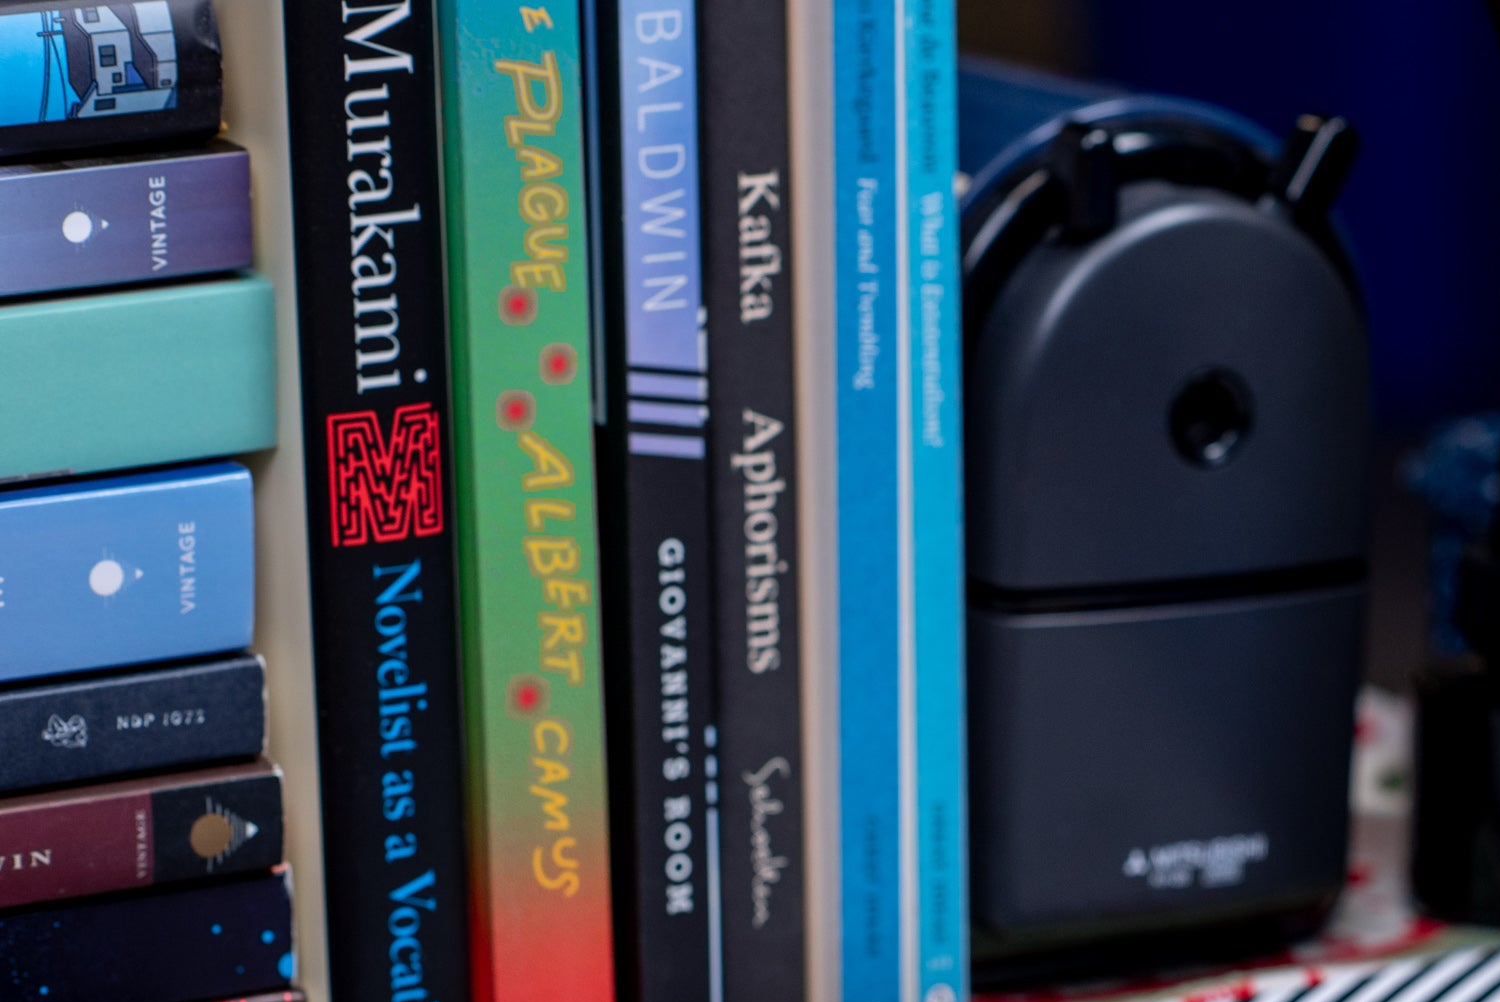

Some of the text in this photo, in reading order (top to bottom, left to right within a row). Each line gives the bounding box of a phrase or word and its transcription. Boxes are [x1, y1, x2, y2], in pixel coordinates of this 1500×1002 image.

[148, 176, 168, 271] VINTAGE
[341, 0, 428, 395] Murakami
[495, 51, 568, 291] PLAGUE
[635, 9, 688, 312] BALDWIN
[856, 178, 879, 225] Fear
[737, 168, 782, 324] Kafka
[857, 229, 880, 274] and
[178, 521, 196, 614] VINTAGE
[518, 431, 592, 688] ALBERT
[731, 409, 788, 674] Aphorisms
[372, 559, 428, 758] Novelist
[658, 537, 693, 914] GIOVANNI'S ROOM
[135, 808, 148, 879] VINTAGE
[382, 770, 415, 821] as
[385, 833, 417, 863] a
[529, 719, 581, 897] CAMUS
